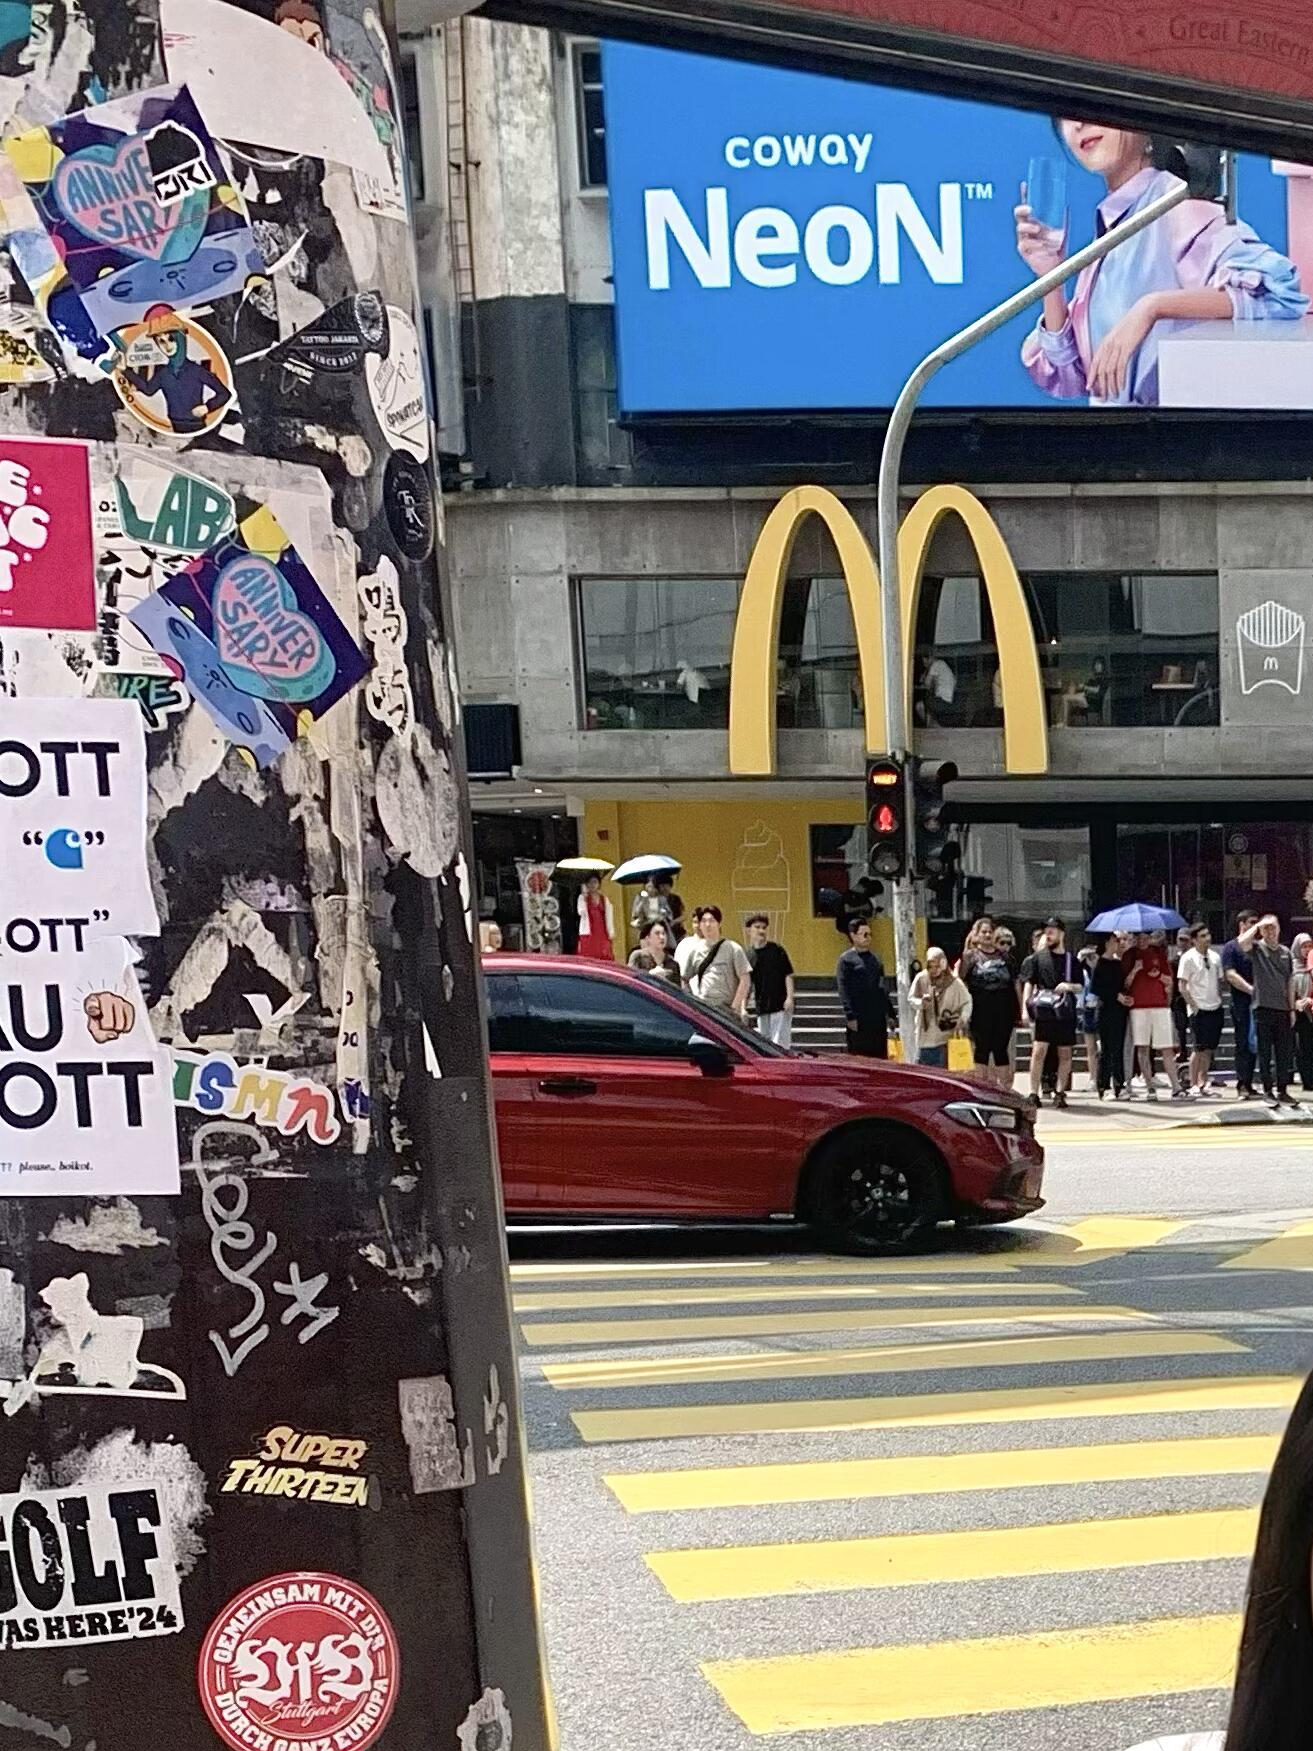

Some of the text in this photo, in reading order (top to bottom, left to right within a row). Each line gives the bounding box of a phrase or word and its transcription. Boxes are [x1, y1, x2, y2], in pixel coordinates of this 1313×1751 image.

[724, 132, 874, 174] coway
[229, 567, 317, 671] ANNIVER
[258, 1426, 369, 1471] SUPER
[220, 1459, 369, 1507] THIRTEEN
[0, 1618, 40, 1649] AS
[213, 1583, 321, 1664] GEMEINSAM
[323, 1587, 366, 1619] MIT
[260, 1697, 351, 1728] Stuttgart
[332, 1677, 390, 1750] EUROPA
